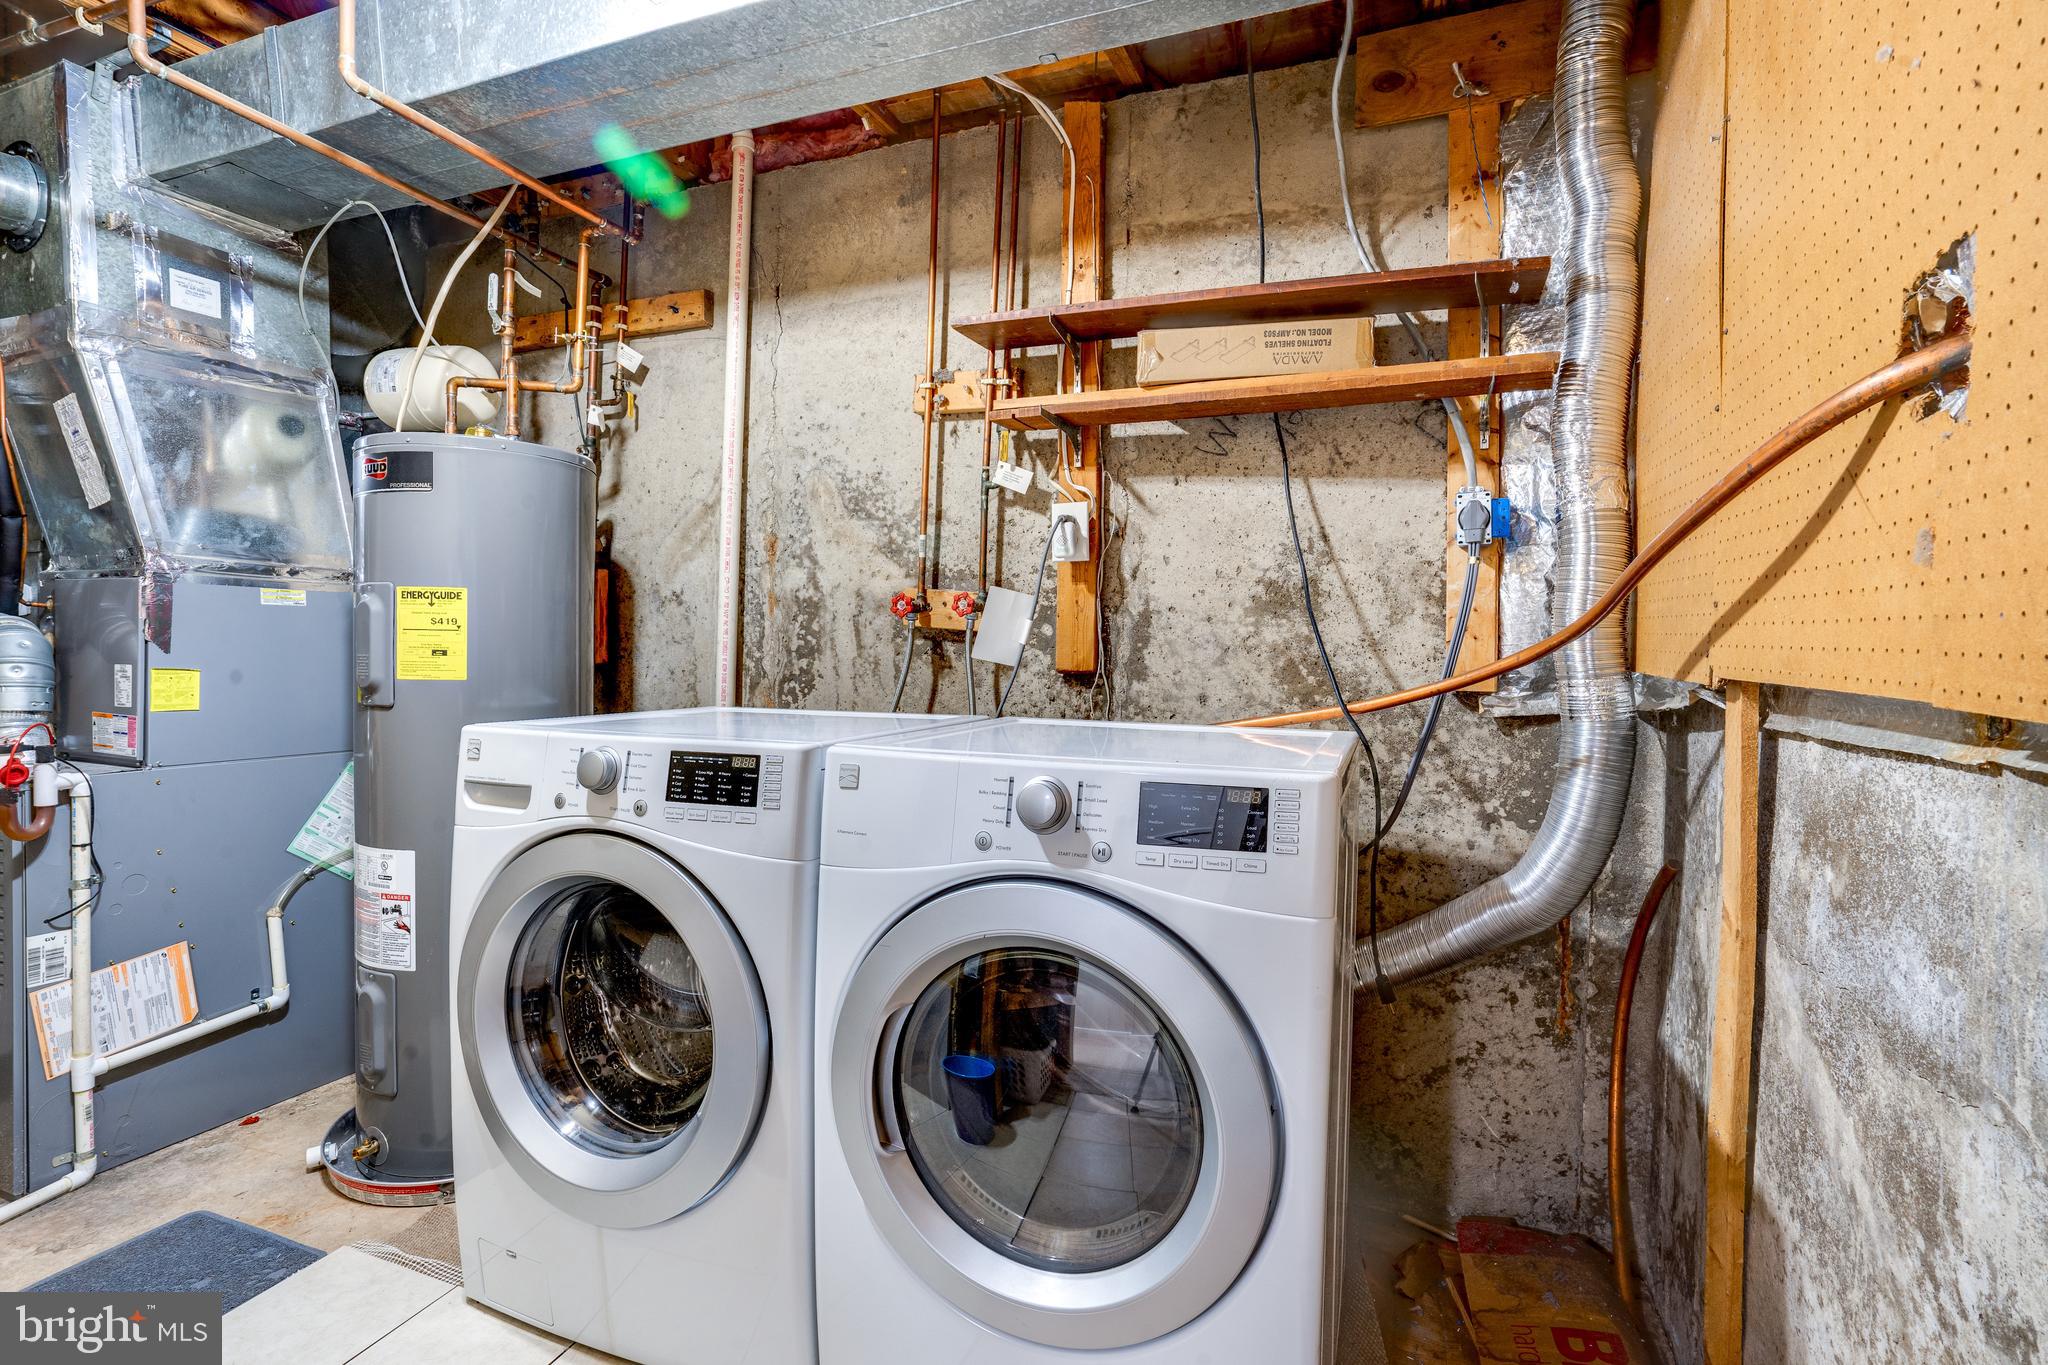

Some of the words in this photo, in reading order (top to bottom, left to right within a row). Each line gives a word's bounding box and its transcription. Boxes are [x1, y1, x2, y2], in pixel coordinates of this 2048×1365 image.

[1308, 328, 1332, 336] MODEL
[1264, 340, 1296, 348] SHELVES
[1297, 339, 1332, 348] FLOATING
[1273, 354, 1323, 365] AMADA
[401, 590, 463, 600] ENERGYGUIDE
[430, 617, 458, 626] $419
[1551, 1326, 1630, 1365] B
